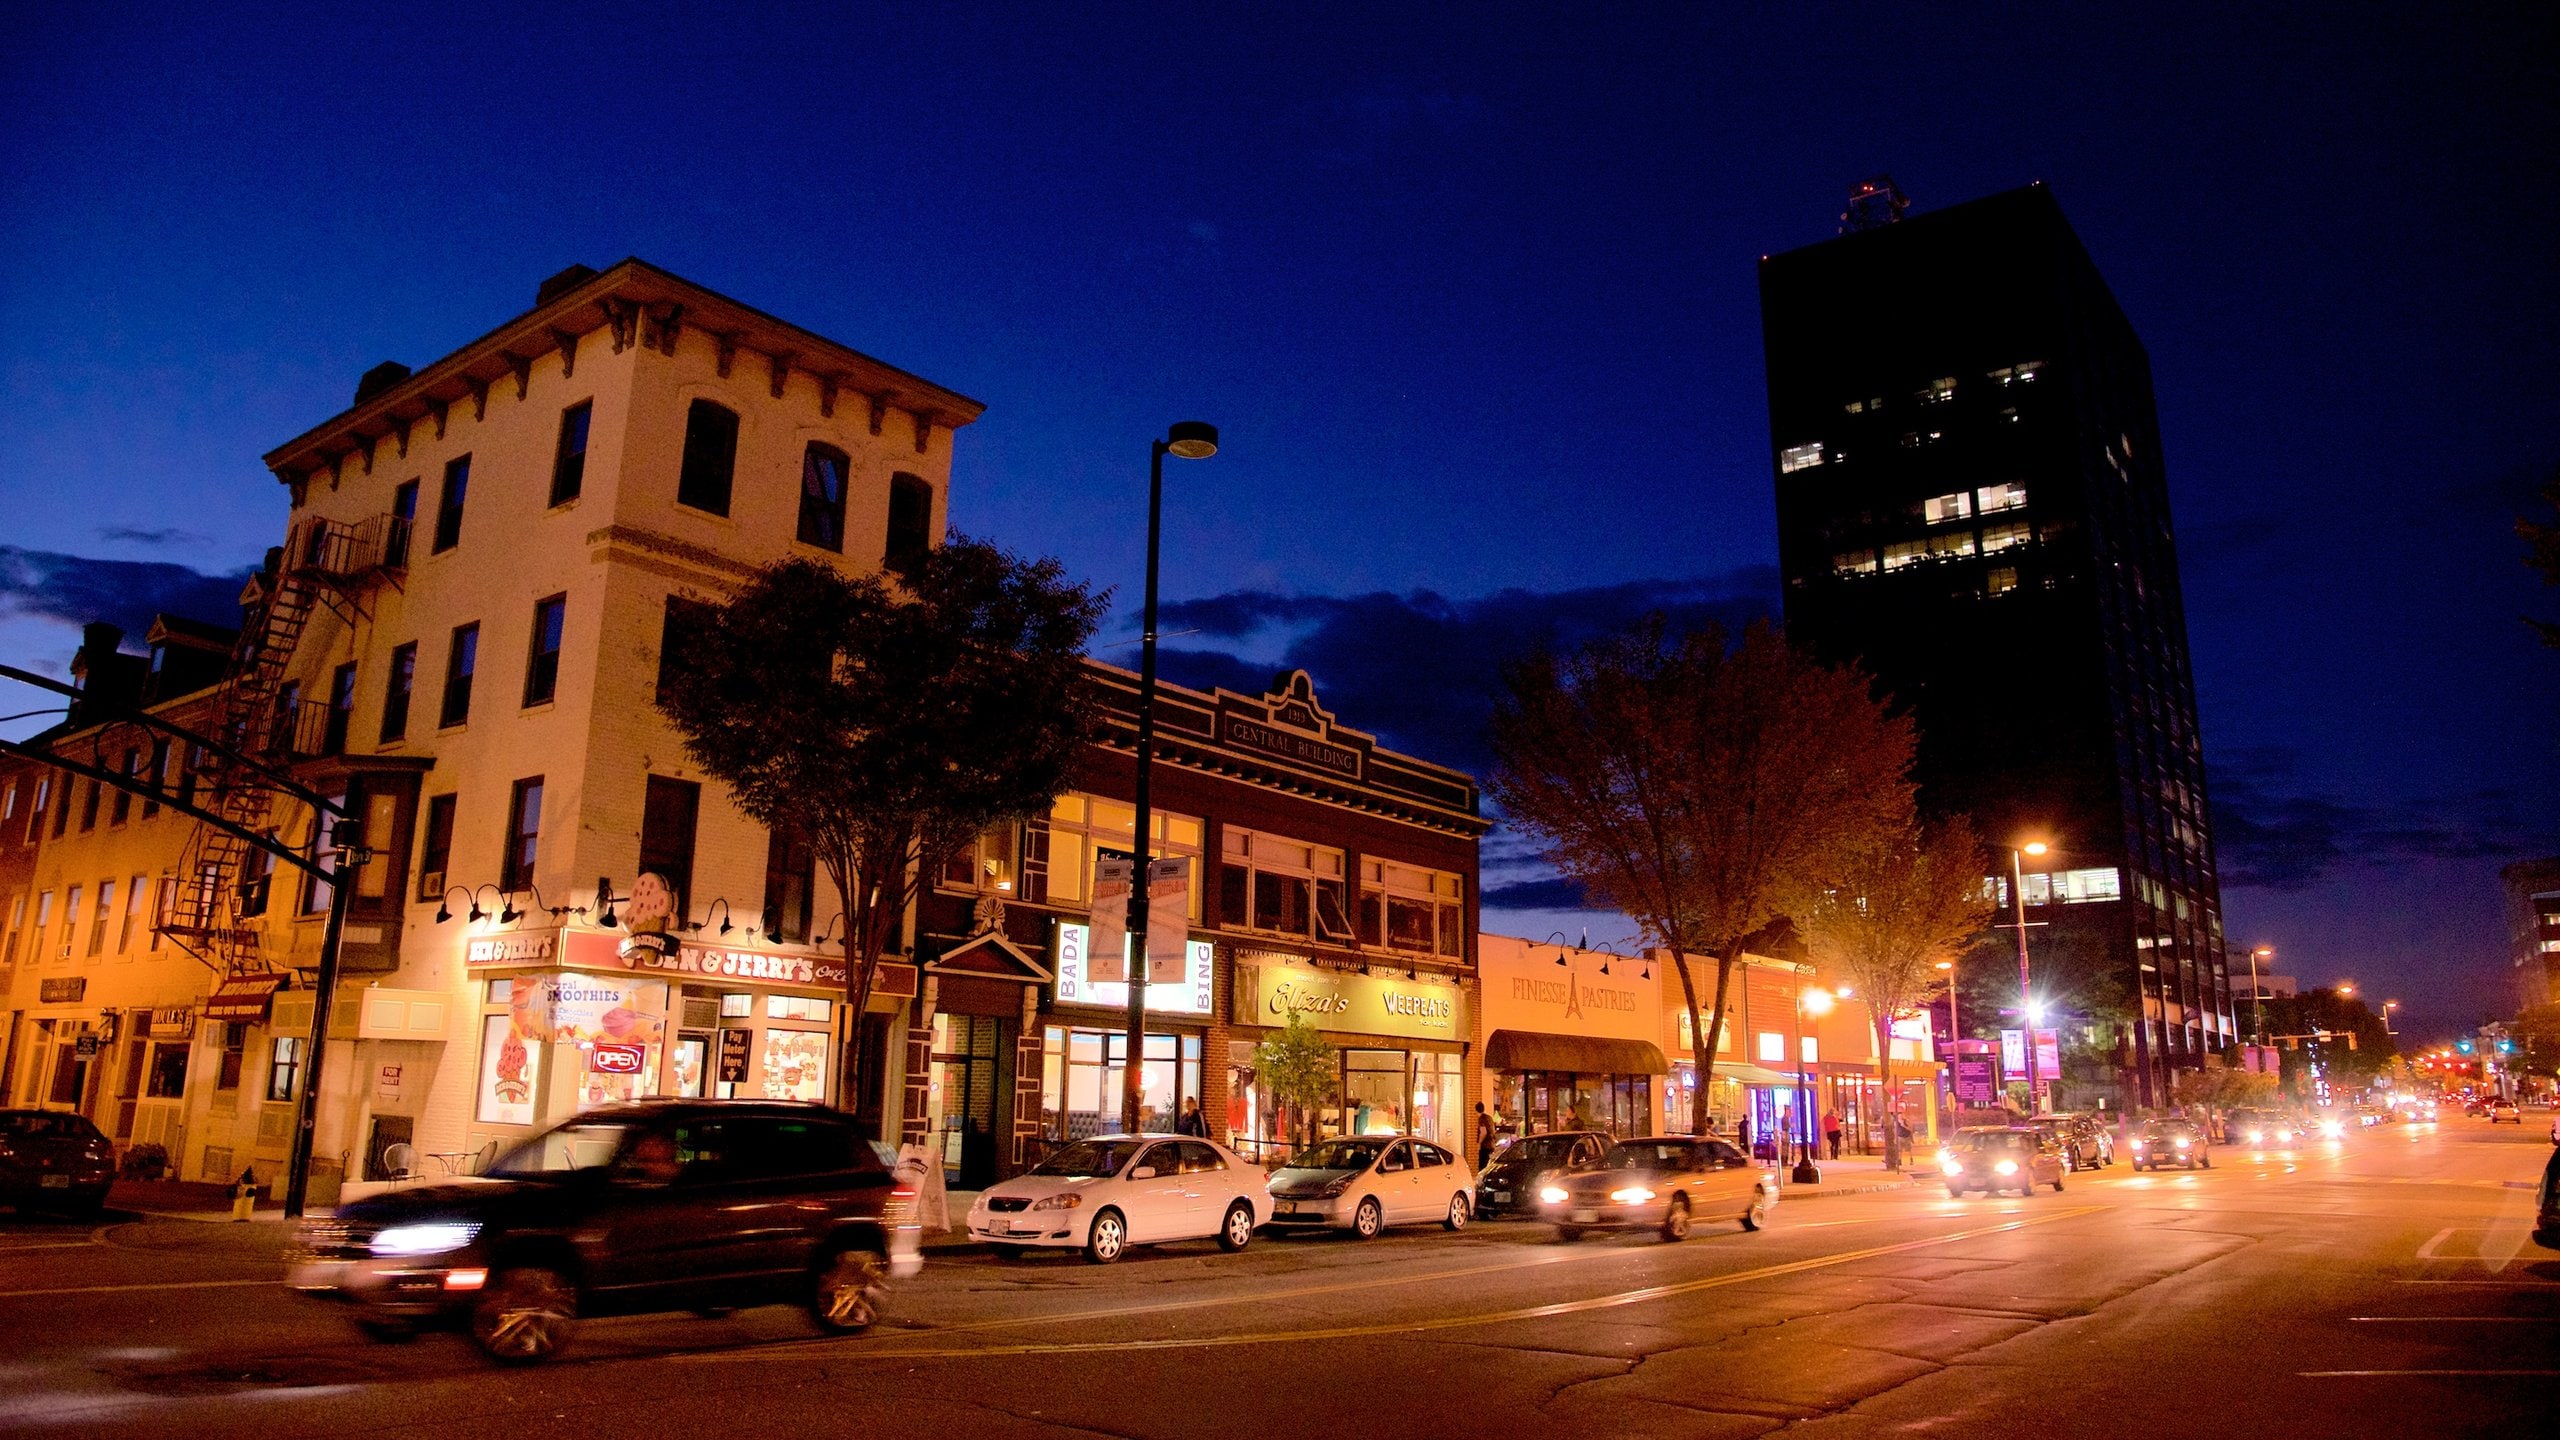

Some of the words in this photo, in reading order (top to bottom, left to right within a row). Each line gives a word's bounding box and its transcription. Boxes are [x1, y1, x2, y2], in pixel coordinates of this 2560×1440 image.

[1233, 723, 1292, 752] CENTRAL
[1298, 741, 1352, 769] BUILDING
[468, 941, 495, 962] BEN
[493, 940, 505, 961] &
[504, 936, 552, 961] JERRY'S
[701, 950, 723, 974] &
[723, 952, 814, 983] JERRY'S
[1061, 928, 1079, 998] BADA
[1197, 945, 1210, 1010] BING
[546, 989, 620, 1003] SMOOTHIES
[1269, 981, 1350, 1015] Eliza's
[1382, 991, 1450, 1018] WEEPEATS
[1511, 977, 1567, 1005] FINESSE
[1581, 986, 1636, 1012] PASTRIES
[723, 1043, 746, 1055] Meter
[729, 1031, 744, 1043] Pay
[597, 1051, 638, 1067] OPEN
[723, 1055, 743, 1068] Here
